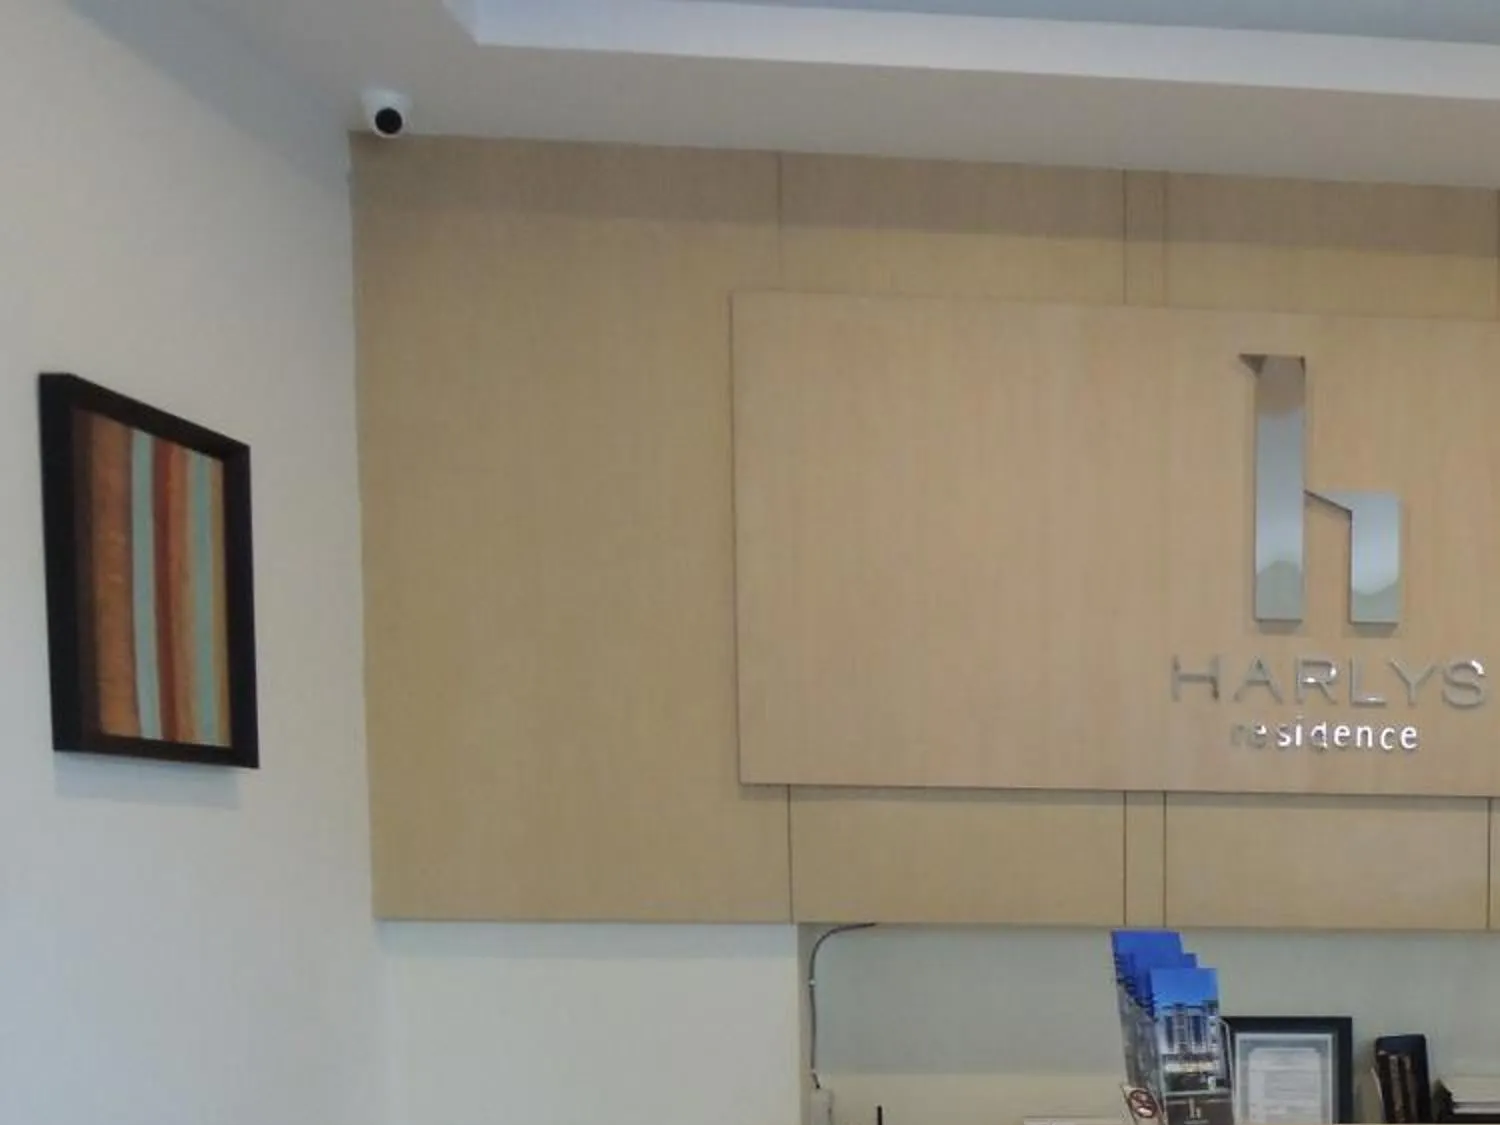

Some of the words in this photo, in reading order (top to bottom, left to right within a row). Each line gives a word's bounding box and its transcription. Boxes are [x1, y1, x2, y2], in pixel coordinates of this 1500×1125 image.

[1238, 353, 1401, 625] h
[1172, 655, 1487, 709] HARLYS
[1230, 715, 1420, 750] residence
